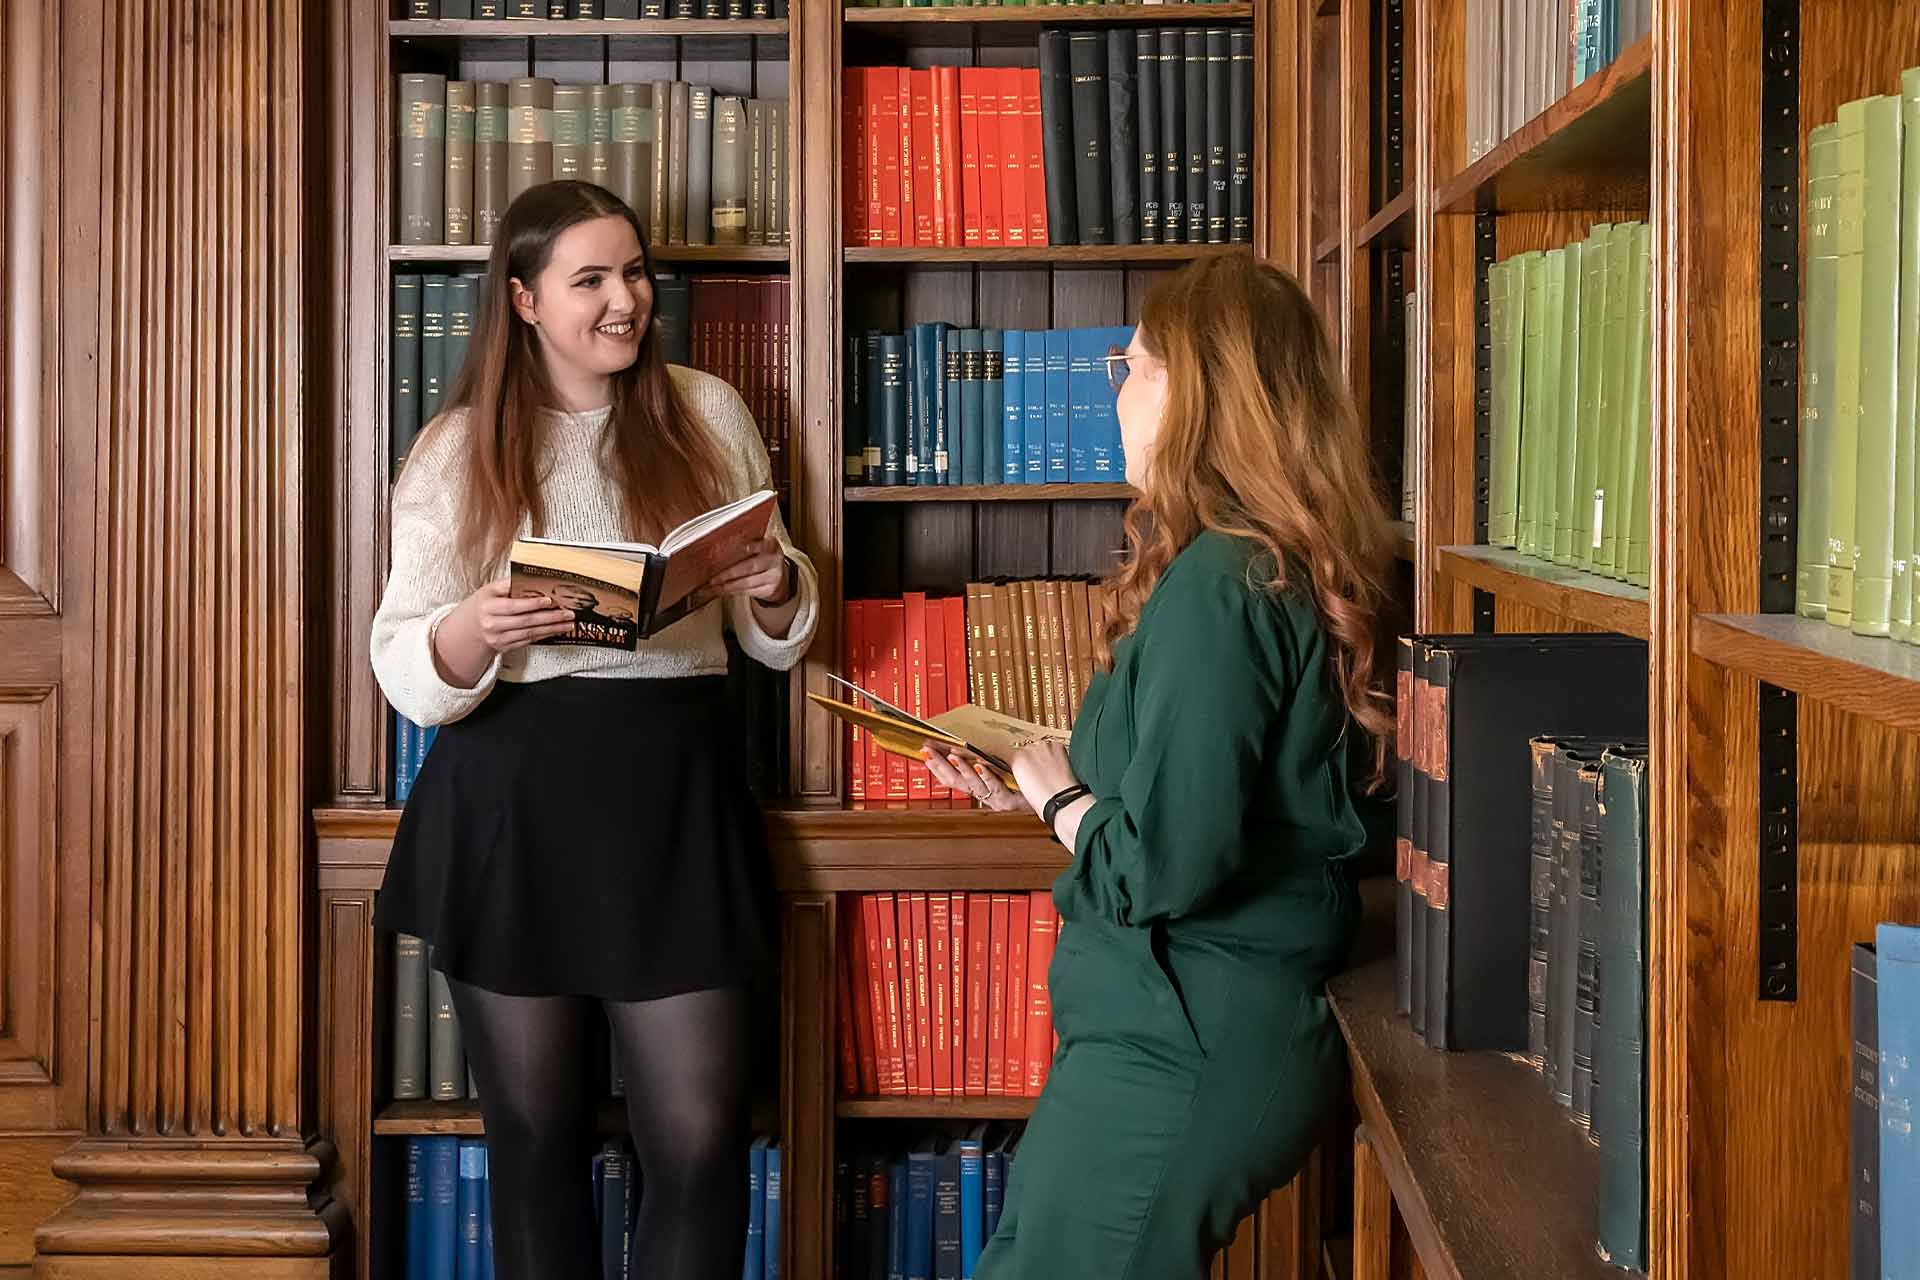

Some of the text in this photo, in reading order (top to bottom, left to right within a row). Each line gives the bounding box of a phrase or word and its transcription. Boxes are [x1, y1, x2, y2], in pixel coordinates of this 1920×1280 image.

[1030, 665, 1039, 707] GEOGRAPHY
[1044, 665, 1052, 708] GEOGRAPHY
[1057, 665, 1065, 707] GEOGRAPHY
